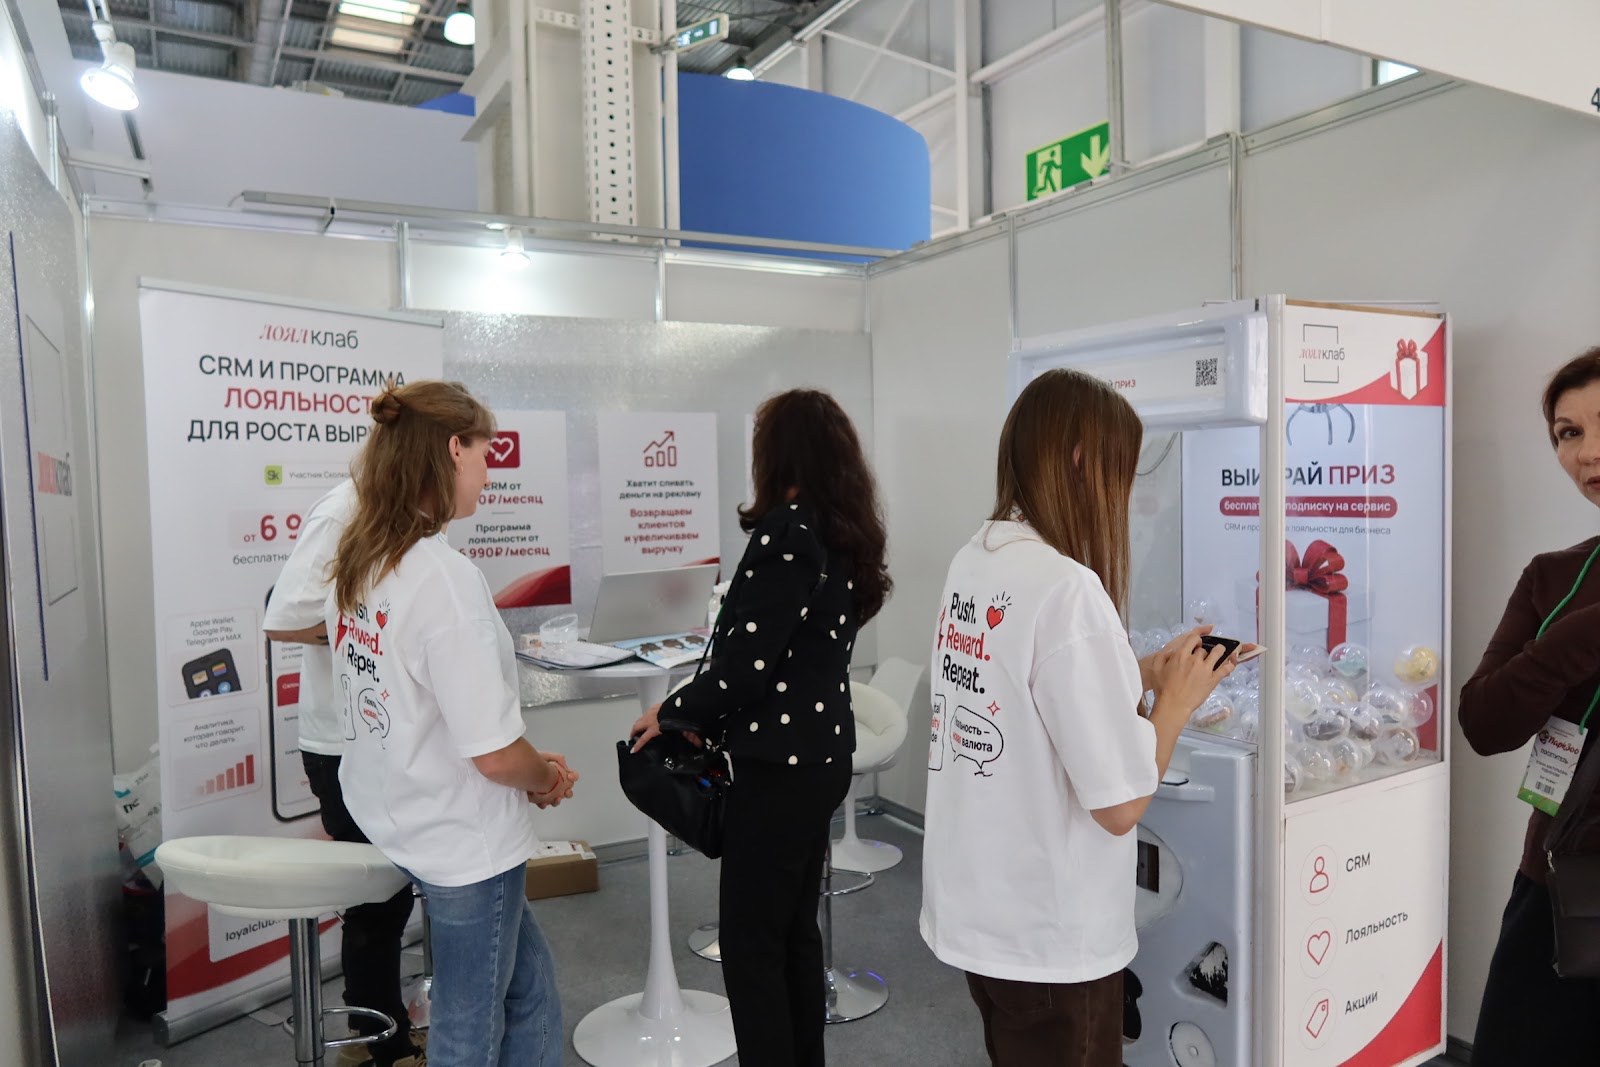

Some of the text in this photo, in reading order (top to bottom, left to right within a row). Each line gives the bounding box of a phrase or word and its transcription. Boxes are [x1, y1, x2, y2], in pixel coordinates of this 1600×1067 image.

[199, 355, 405, 387] CRM И ПРОГРАММА
[1114, 379, 1136, 390] ПРИЗ
[224, 387, 373, 415] ЛОЯЛЬНОСТ
[187, 420, 368, 443] ДЛЯ РОСТА ВЫР
[324, 471, 352, 479] Сколко
[1222, 461, 1396, 486] ВЫИРАЙ ПРИЗ
[509, 483, 521, 491] от
[665, 491, 701, 499] рекламу
[630, 508, 692, 519] Возвращаем
[1224, 501, 1259, 512] бесплат
[1336, 503, 1349, 512] на
[1351, 503, 1391, 514] сервис
[476, 524, 531, 534] Программа
[638, 521, 685, 529] клиентов
[1224, 523, 1240, 532] CRM
[1339, 526, 1354, 535] для
[1355, 526, 1391, 535] бинеса
[243, 534, 256, 543] от
[468, 536, 527, 545] лояльности
[633, 533, 699, 543] увеличиваем
[641, 546, 684, 555] выручку
[950, 592, 977, 625] Push.
[190, 620, 210, 628] Apple
[193, 628, 218, 637] Google
[186, 636, 219, 647] Telegram
[225, 633, 242, 641] MAX
[946, 623, 991, 661] Reward.
[942, 653, 986, 694] Repeat.
[184, 732, 214, 743] которая
[195, 737, 236, 749] что делать
[962, 738, 993, 753] валюта
[1345, 852, 1371, 873] CRM
[225, 919, 284, 941] loyalclub.
[1345, 911, 1409, 944] Лояльность
[1344, 991, 1378, 1015] Акции
